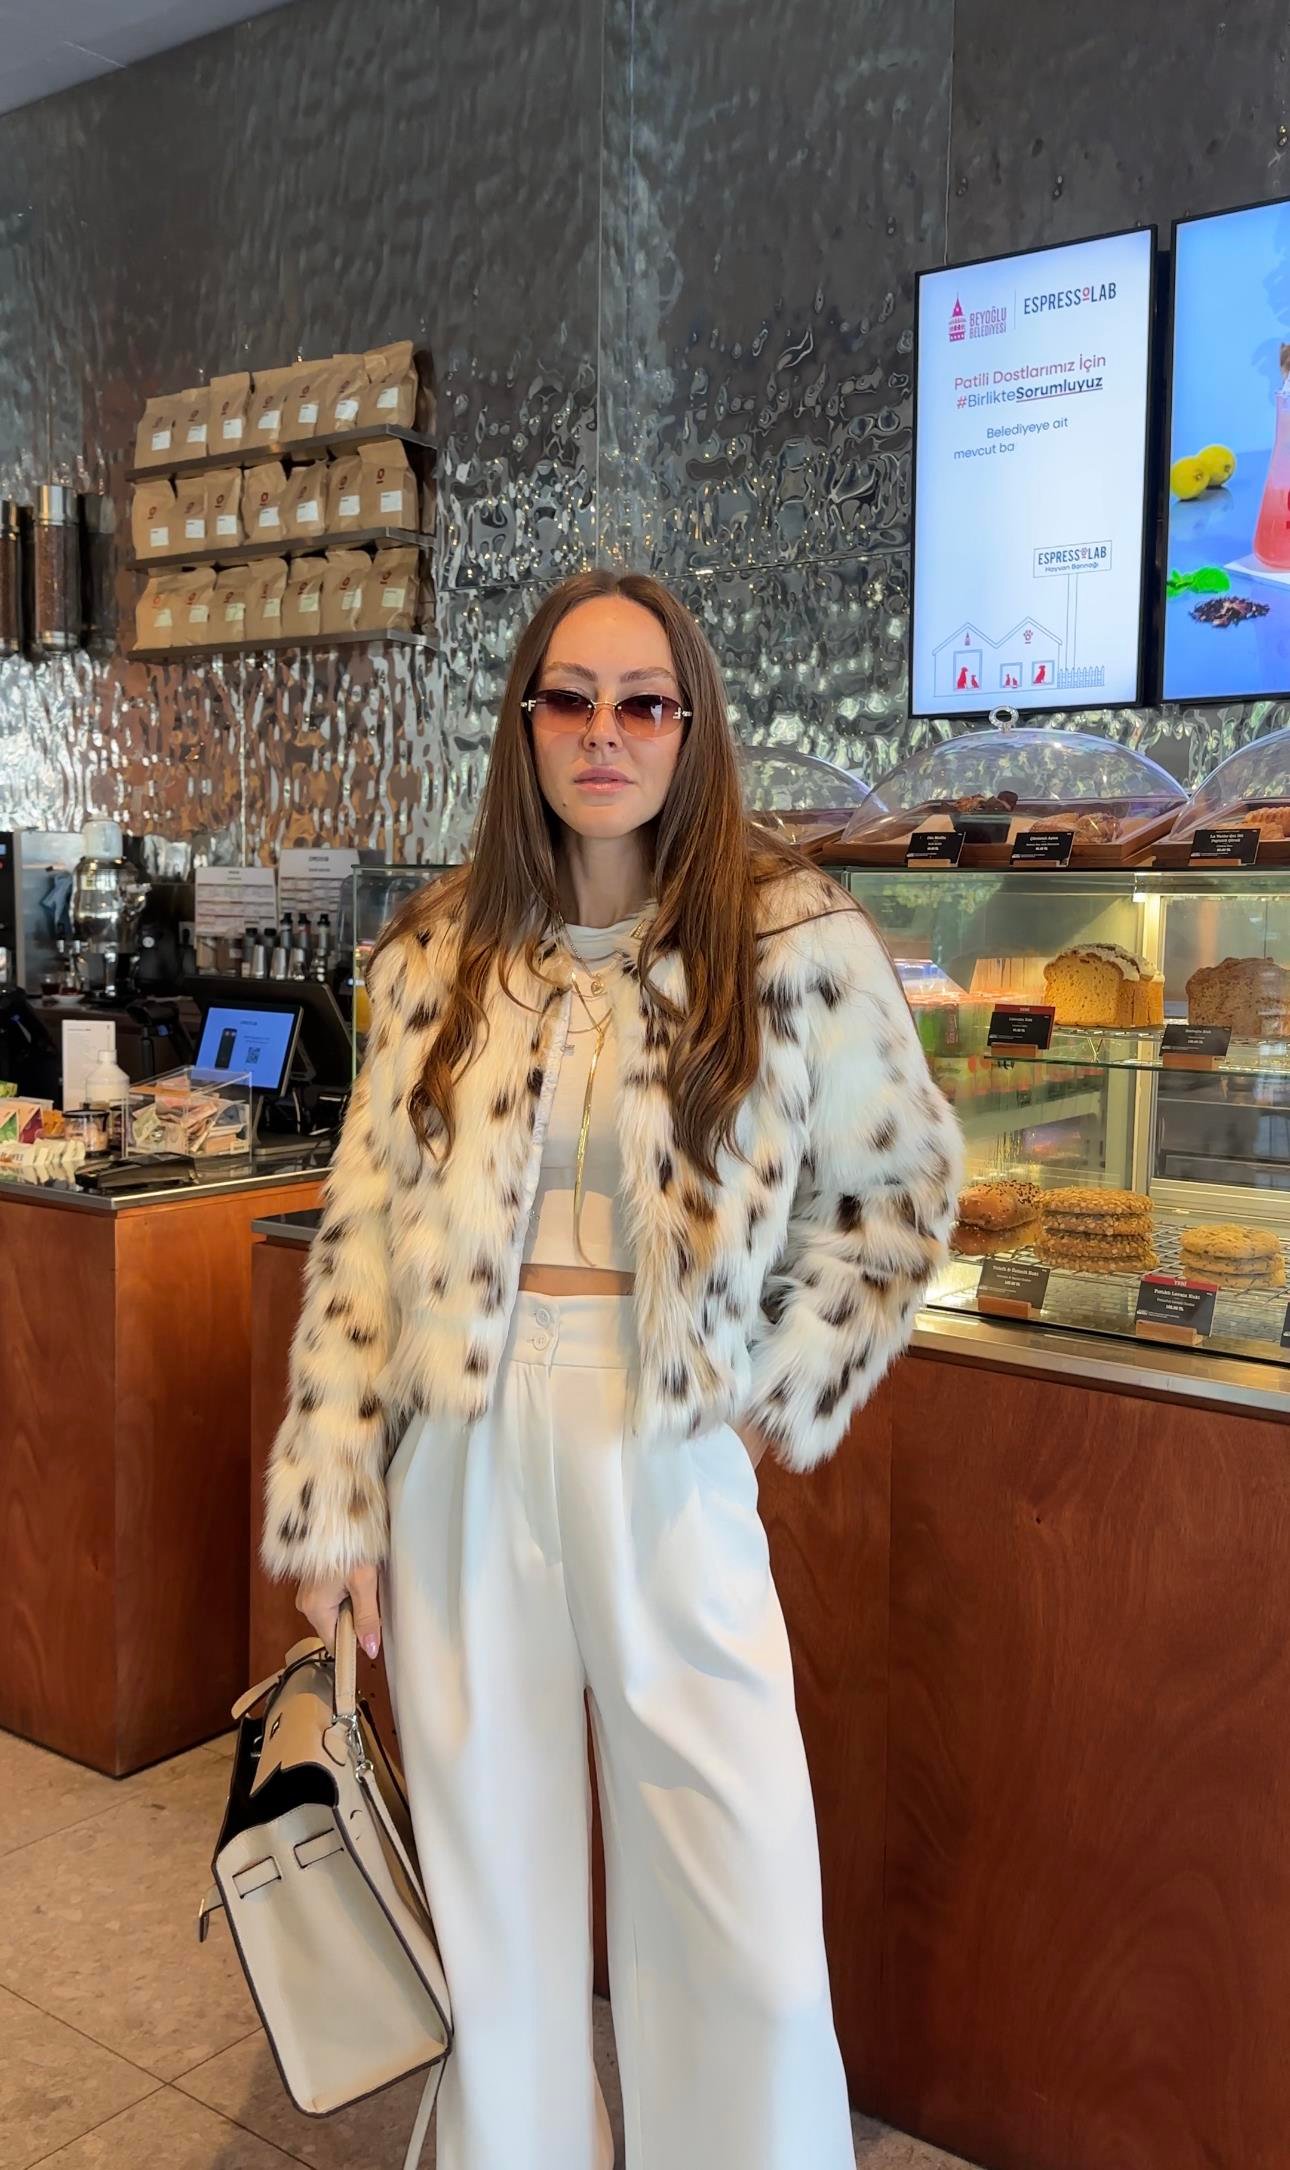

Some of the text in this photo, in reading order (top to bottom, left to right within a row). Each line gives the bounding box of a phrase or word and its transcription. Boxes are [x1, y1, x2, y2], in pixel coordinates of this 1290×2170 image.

[969, 306, 1007, 327] BEYOĞLU
[954, 353, 1106, 390] Patili Dostlarımız İçin
[986, 417, 1069, 439] Belediyeye ait
[953, 442, 1015, 460] mevcut ba
